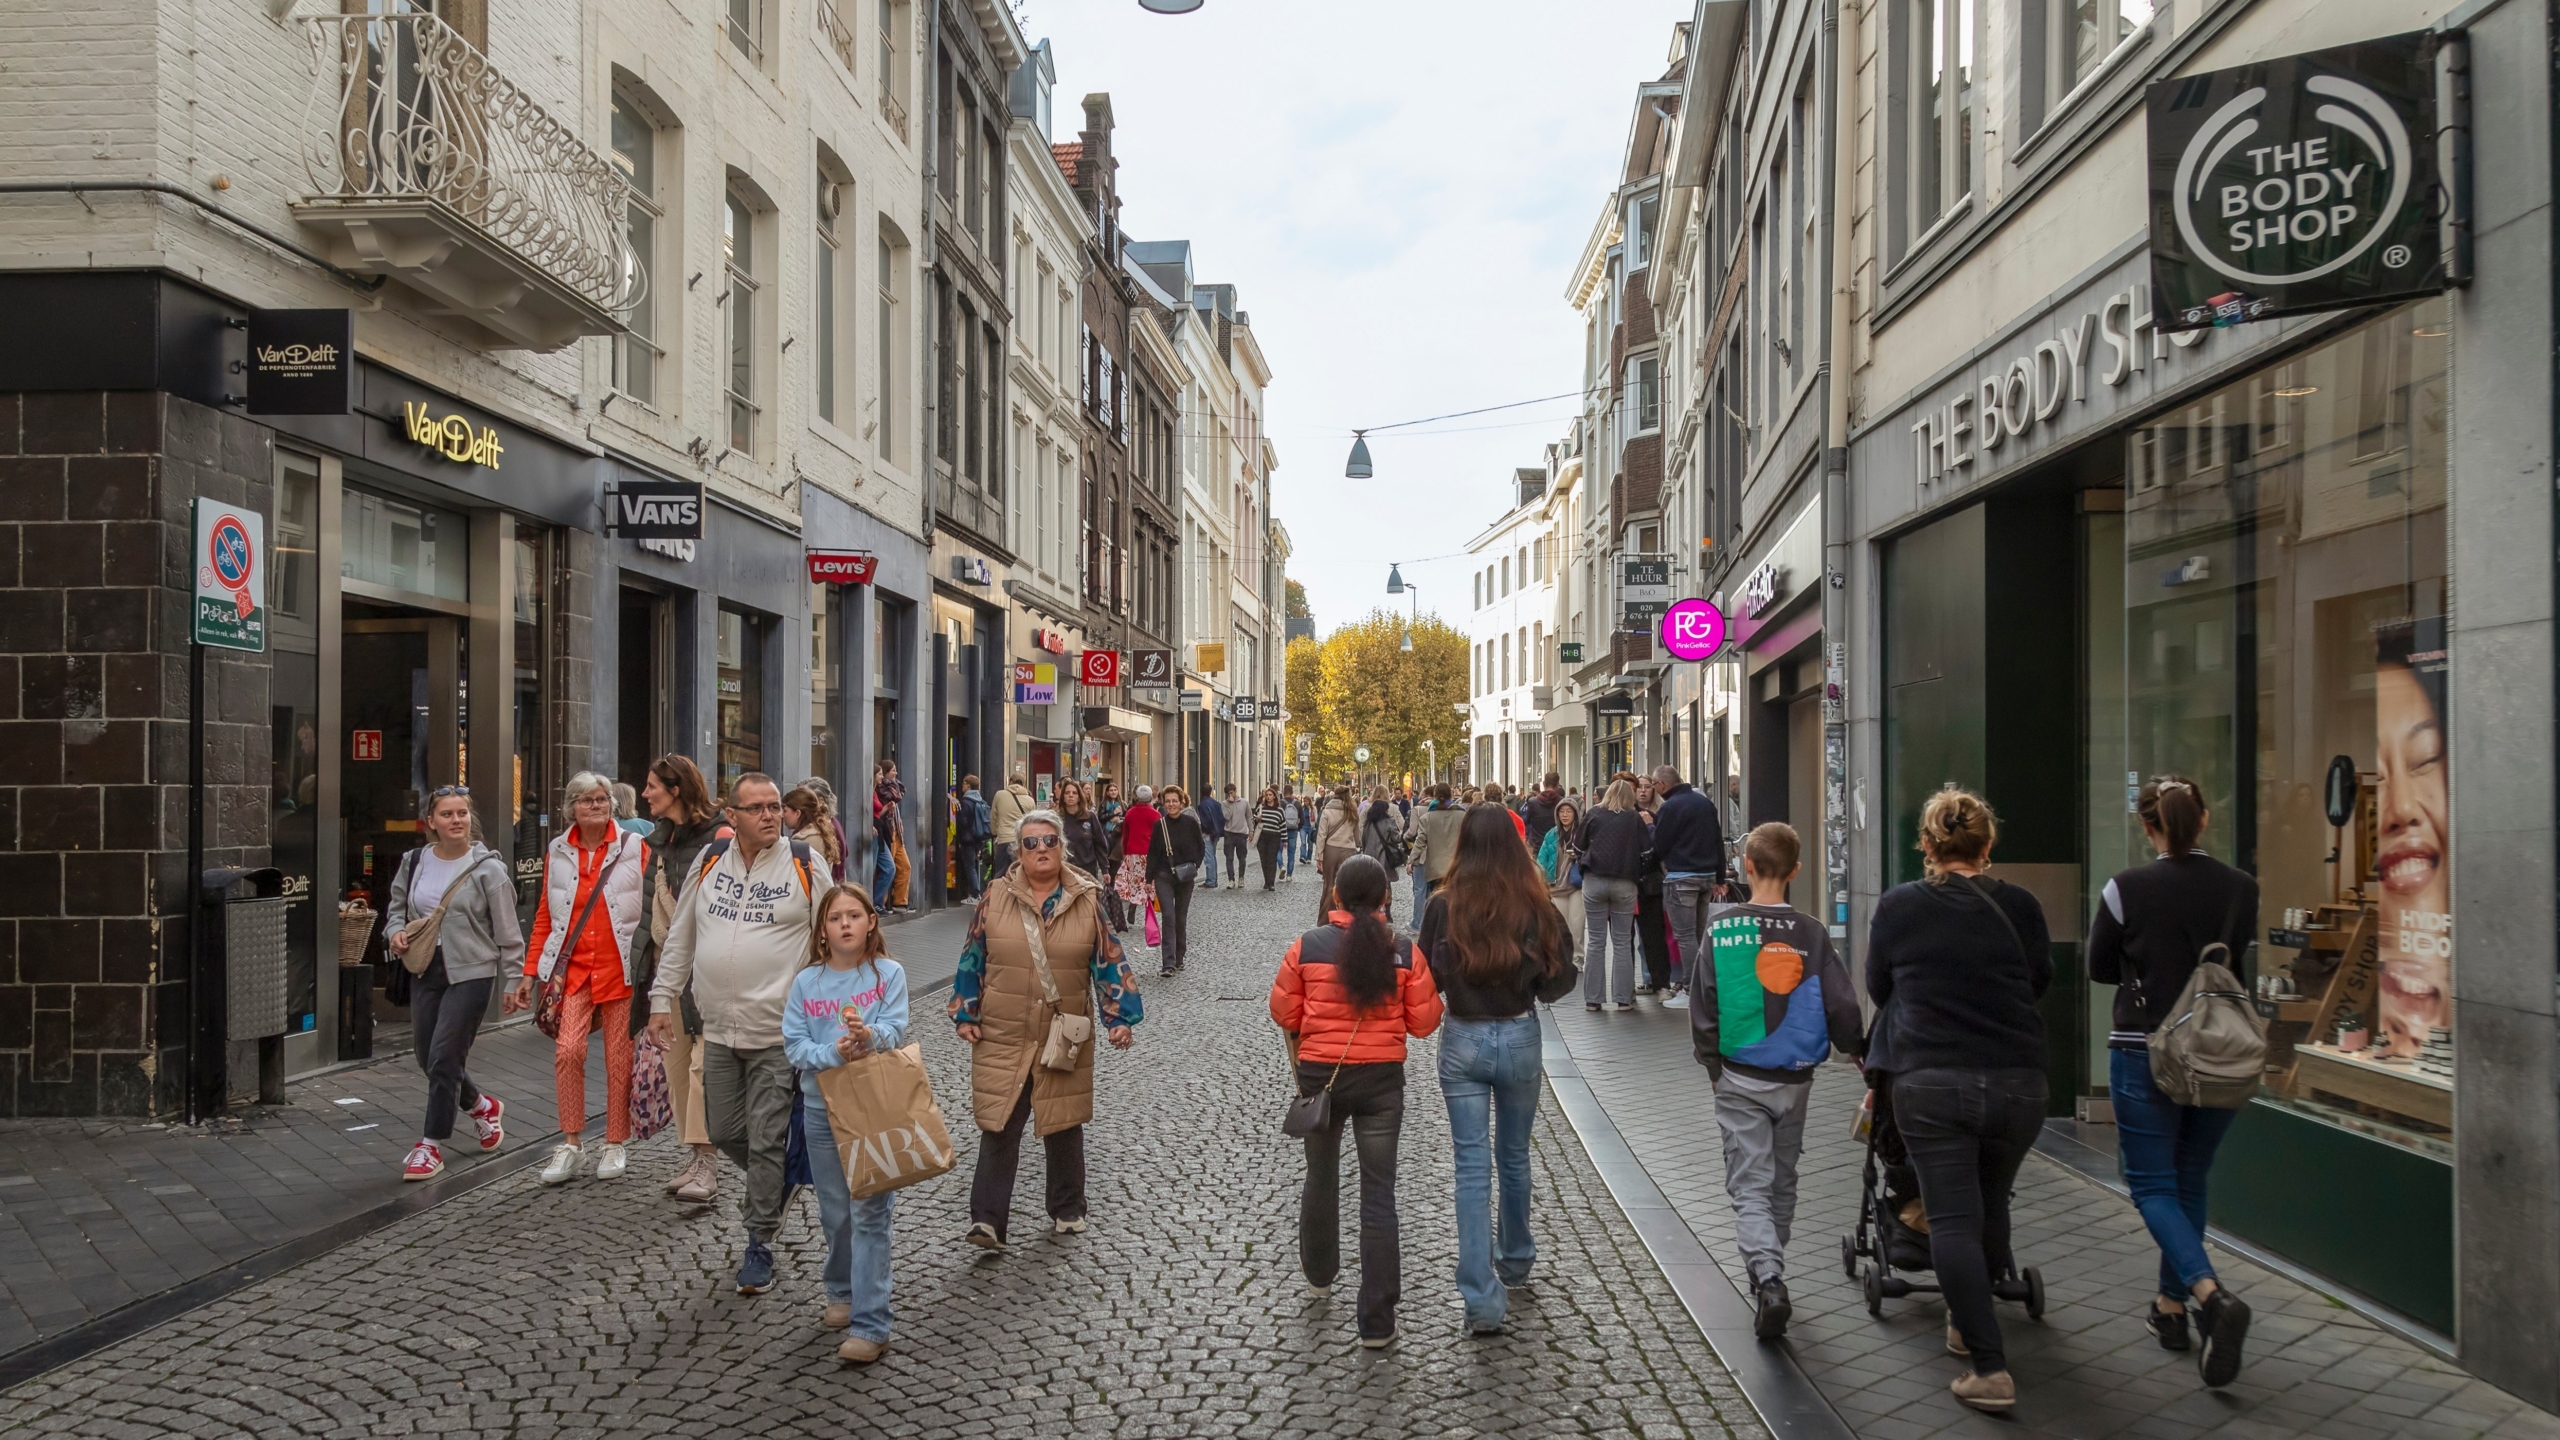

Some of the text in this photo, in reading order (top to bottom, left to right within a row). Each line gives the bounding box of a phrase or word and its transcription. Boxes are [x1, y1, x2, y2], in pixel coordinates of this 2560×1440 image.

[2246, 136, 2329, 176] THE
[2221, 163, 2366, 219] BODY
[2229, 204, 2357, 252] SHOP
[257, 344, 339, 365] Van Delft
[1911, 284, 2208, 486] THE BODY SH
[404, 401, 504, 470] Van Delft
[621, 494, 698, 525] VANS
[1631, 574, 1663, 583] HUUR
[1640, 566, 1655, 574] TE
[1675, 611, 1711, 640] PG
[1015, 666, 1034, 680] So
[1088, 676, 1110, 684] Kruidvat
[1134, 679, 1170, 687] Délifrance
[748, 881, 791, 903] Petrol
[708, 903, 738, 921] UTAH
[743, 911, 778, 924] U.S.A.
[1707, 916, 1796, 937] PERFECTLY
[1713, 934, 1762, 948] IMPLE
[1787, 947, 1808, 957] CREATE
[803, 998, 841, 1018] NEW
[838, 1119, 949, 1192] ZARA
